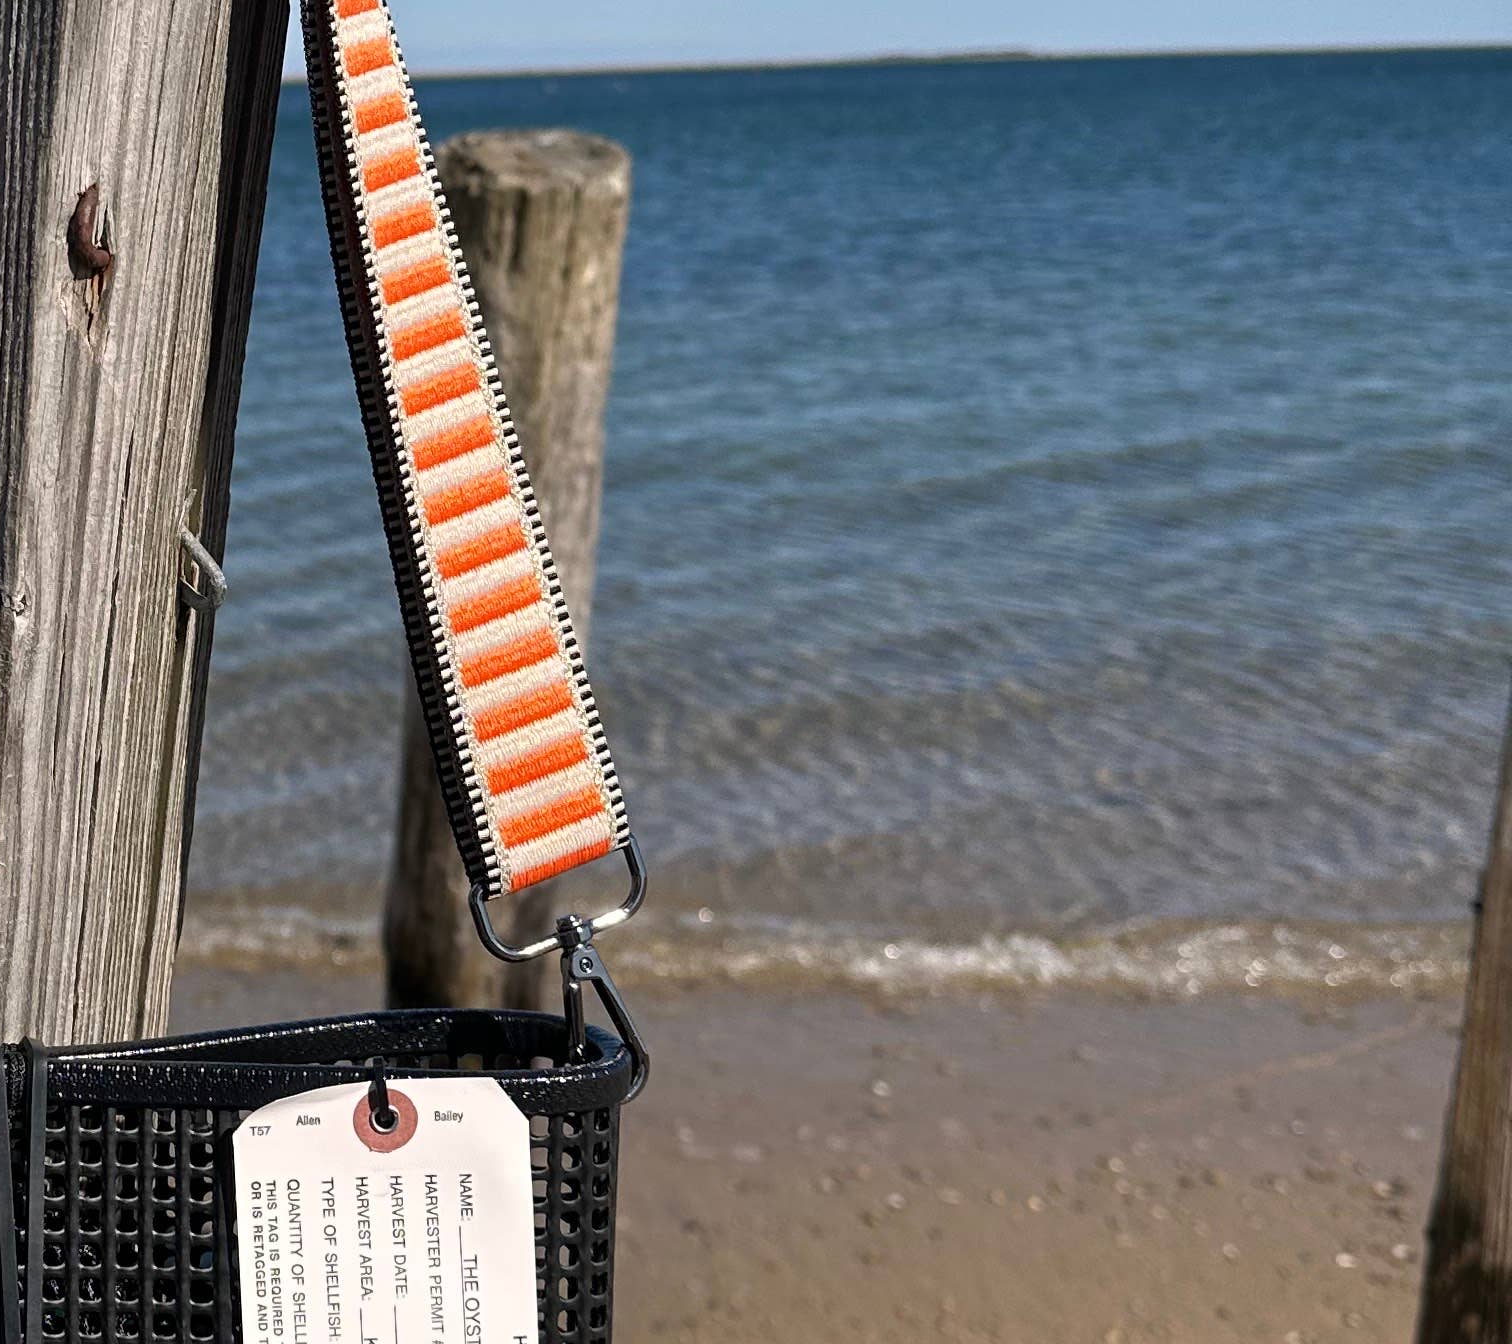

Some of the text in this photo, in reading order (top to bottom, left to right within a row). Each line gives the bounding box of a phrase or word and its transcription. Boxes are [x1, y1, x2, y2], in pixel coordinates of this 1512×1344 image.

[249, 1125, 272, 1136] T57
[296, 1110, 464, 1126] Allen Bailey
[250, 1180, 262, 1200] OR
[265, 1179, 278, 1210] THIS
[389, 1175, 406, 1248] HARVEST
[458, 1173, 473, 1221] NAME:
[251, 1206, 263, 1219] IS
[267, 1216, 279, 1243] TAG
[287, 1178, 304, 1258] QUANTITY
[355, 1176, 371, 1250] HARVEST
[424, 1174, 441, 1268] HARVESTER
[253, 1225, 267, 1298] RETAGGED
[269, 1248, 280, 1262] IS
[291, 1263, 305, 1286] OF
[321, 1176, 341, 1342] TYPE OF SHELLFISH:
[393, 1254, 408, 1298] DATE:
[463, 1254, 479, 1292] THE
[359, 1254, 373, 1301] AREA:
[257, 1303, 268, 1332] AND
[270, 1267, 284, 1337] REQUIRED
[429, 1274, 444, 1334] PERMIT
